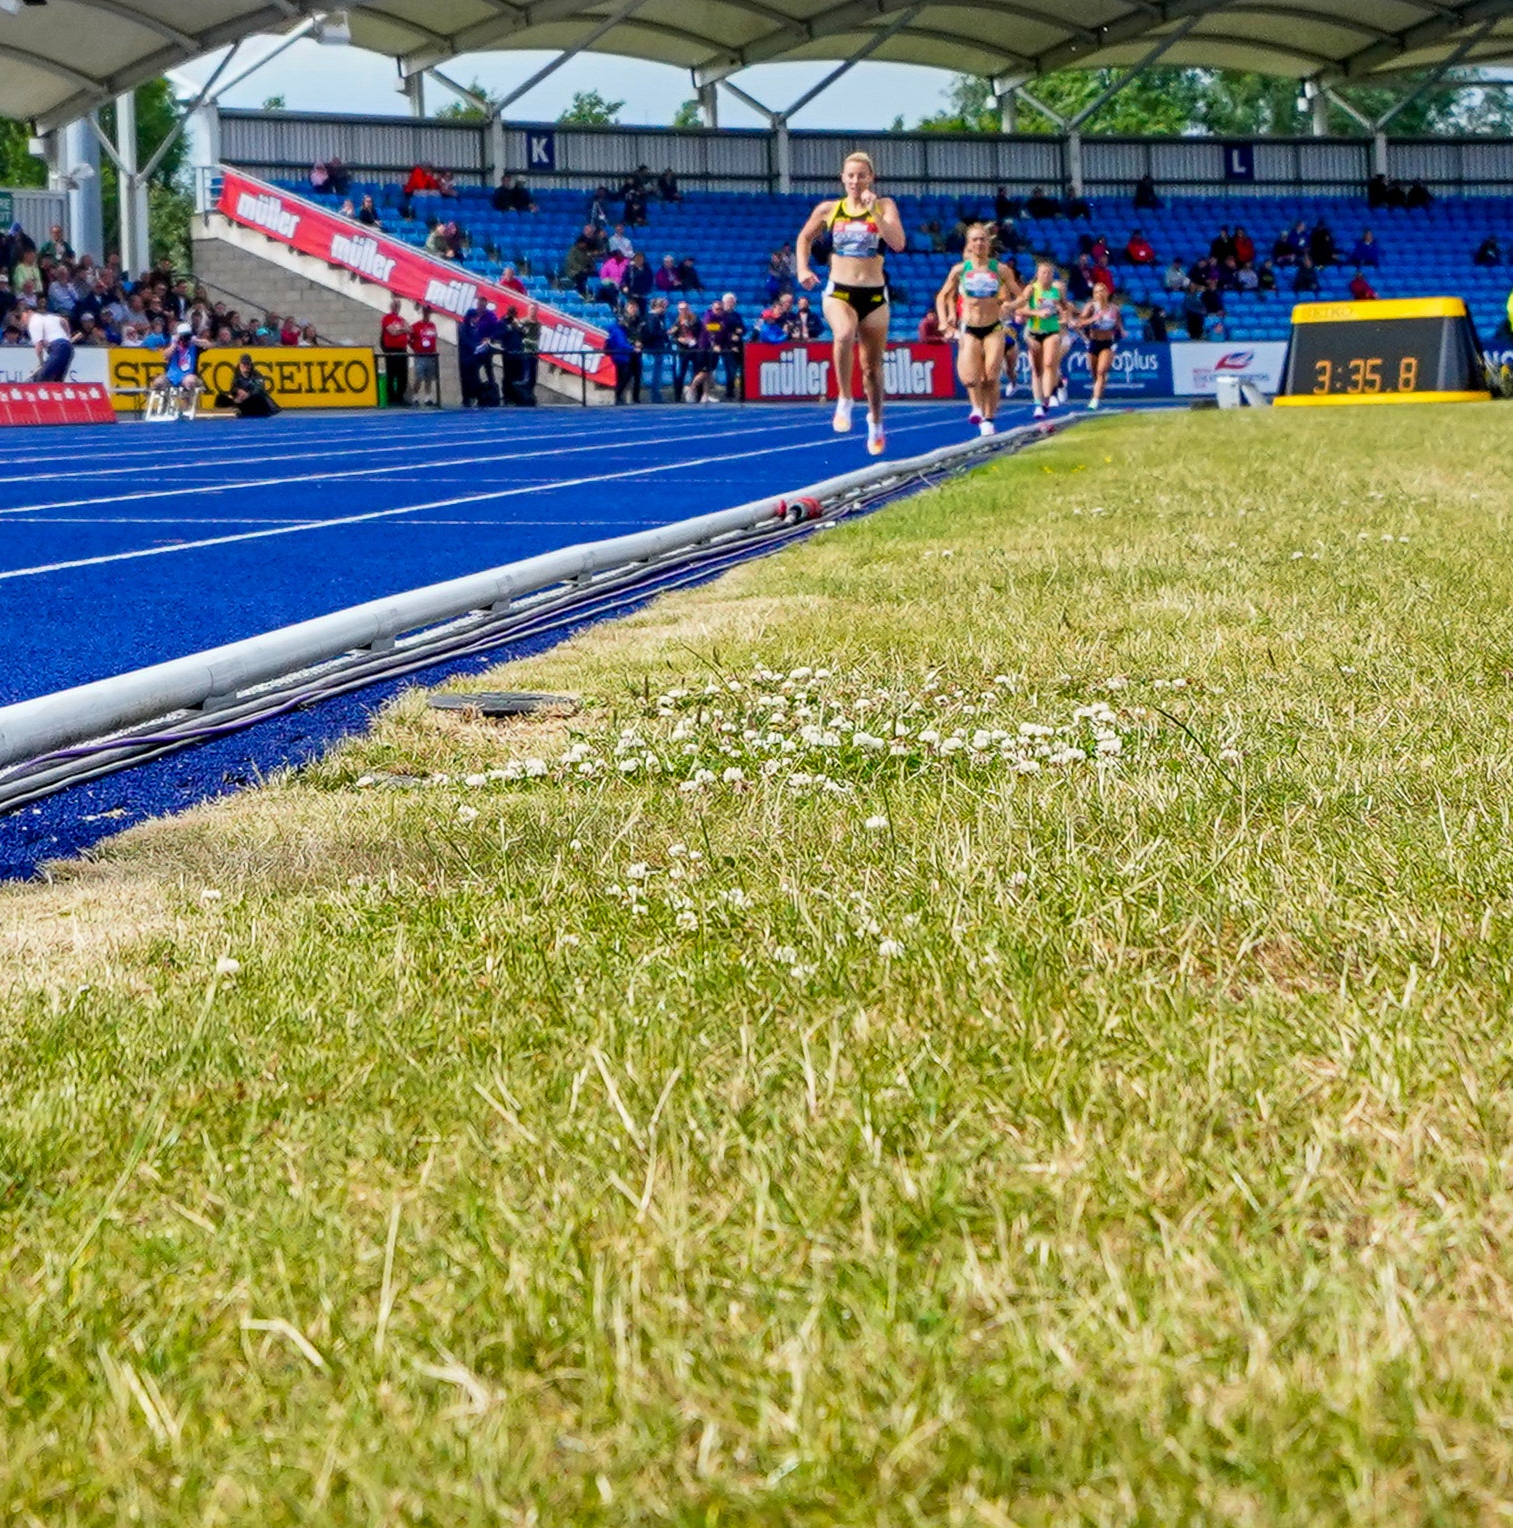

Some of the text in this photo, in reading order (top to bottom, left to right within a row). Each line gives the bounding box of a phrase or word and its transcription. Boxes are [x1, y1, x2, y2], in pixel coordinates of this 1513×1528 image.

[532, 137, 550, 164] K
[1232, 149, 1246, 173] L
[237, 192, 301, 239] müller
[330, 233, 397, 283] müller
[759, 347, 830, 396] müller
[881, 347, 935, 395] üller
[1313, 356, 1418, 394] 3:35.8
